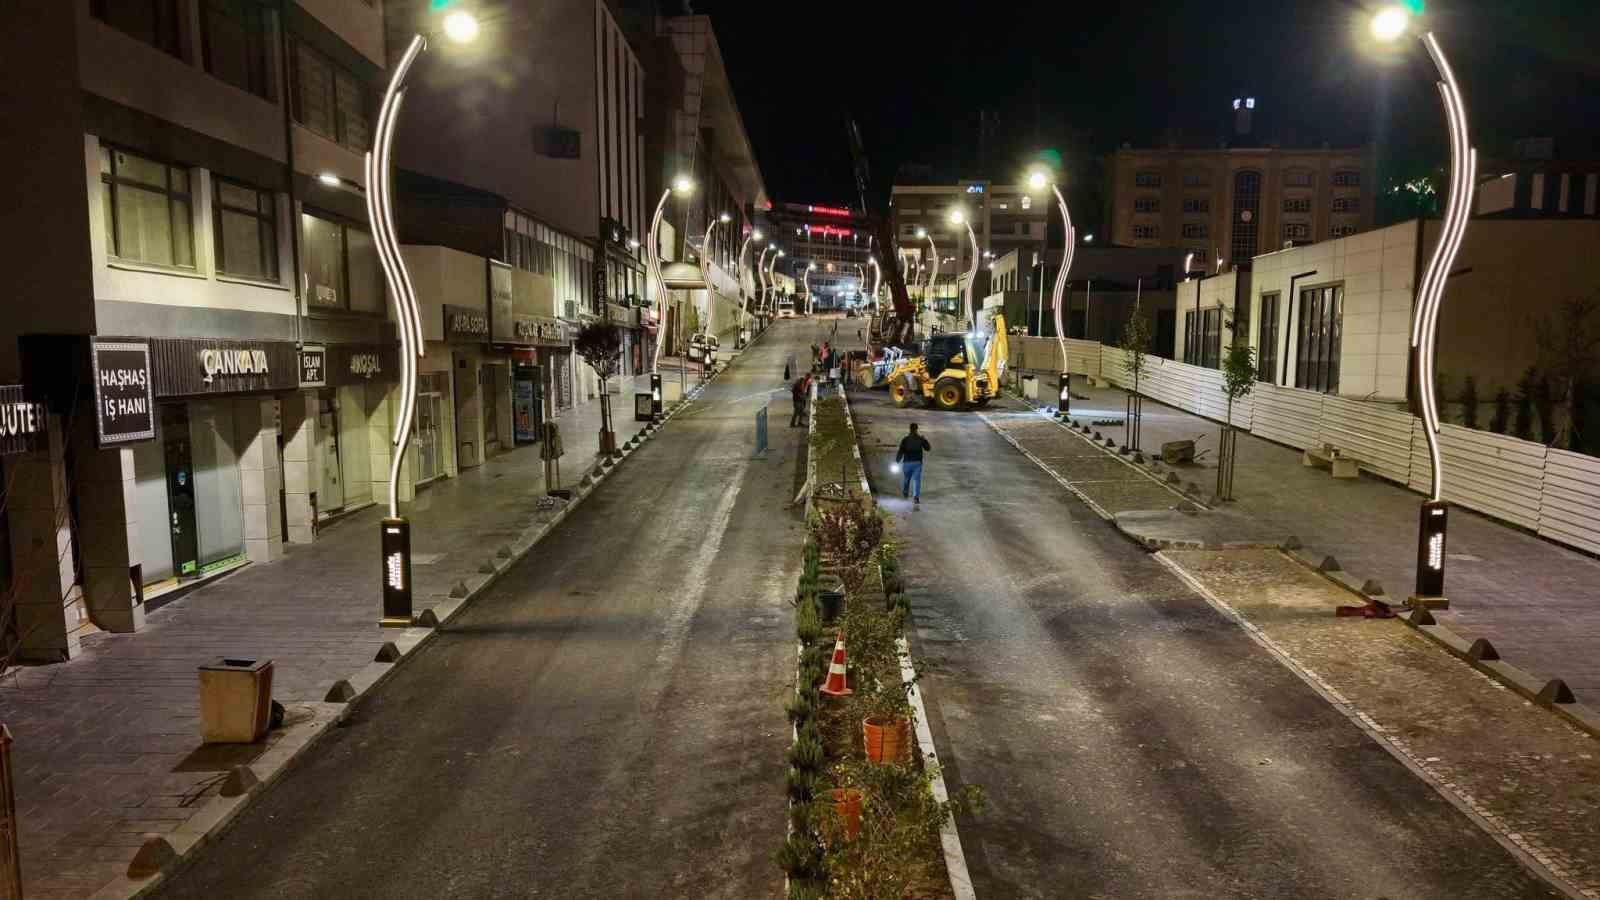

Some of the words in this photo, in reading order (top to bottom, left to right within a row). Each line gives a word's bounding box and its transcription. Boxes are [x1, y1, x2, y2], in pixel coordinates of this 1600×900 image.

[201, 349, 269, 383] ÇANKAYA
[303, 352, 321, 368] İSLAM
[100, 368, 146, 391] HAŞHAŞ
[305, 369, 318, 381] APT.
[104, 395, 116, 422] İŞ
[118, 397, 146, 416] HANI
